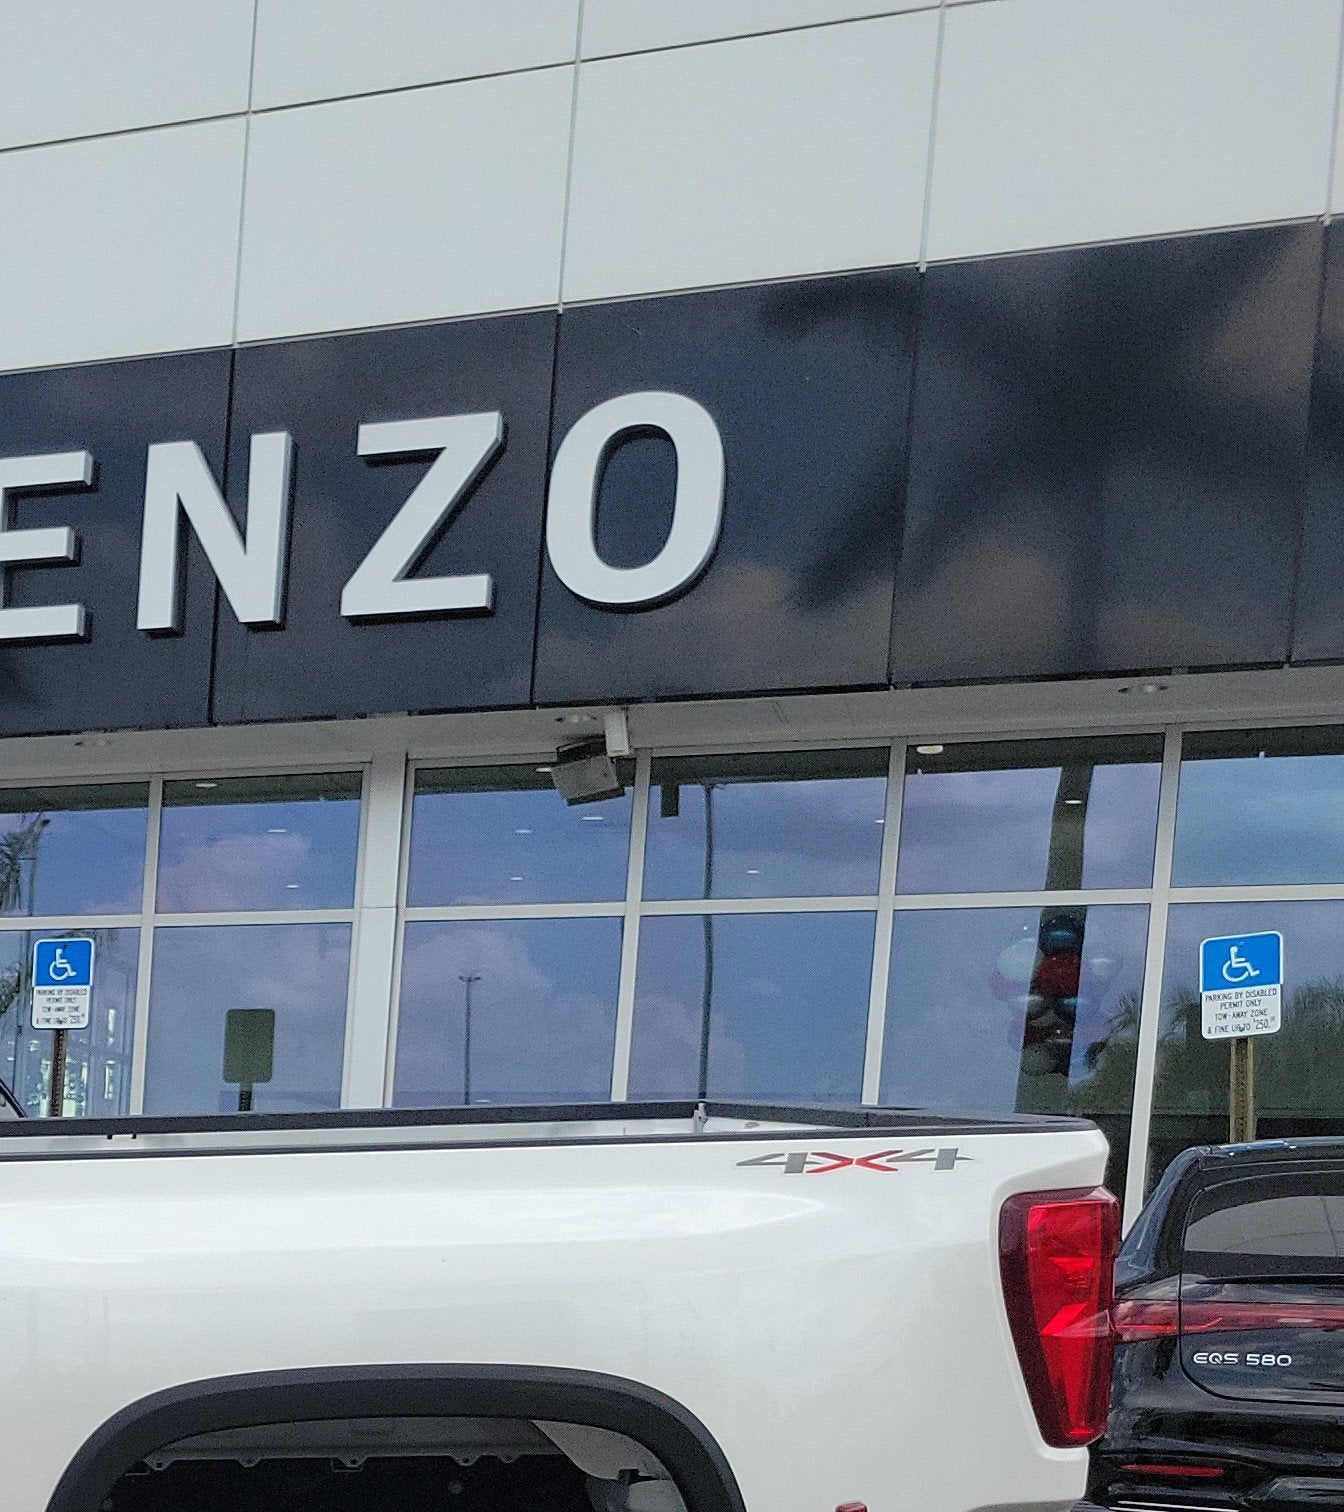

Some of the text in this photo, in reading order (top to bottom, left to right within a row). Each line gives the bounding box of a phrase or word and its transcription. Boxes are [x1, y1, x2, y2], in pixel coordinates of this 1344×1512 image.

[1205, 988, 1277, 1002] PARKING BY DISABLED
[1245, 999, 1262, 1008] ONLY
[1192, 1352, 1293, 1367] EQS 580
